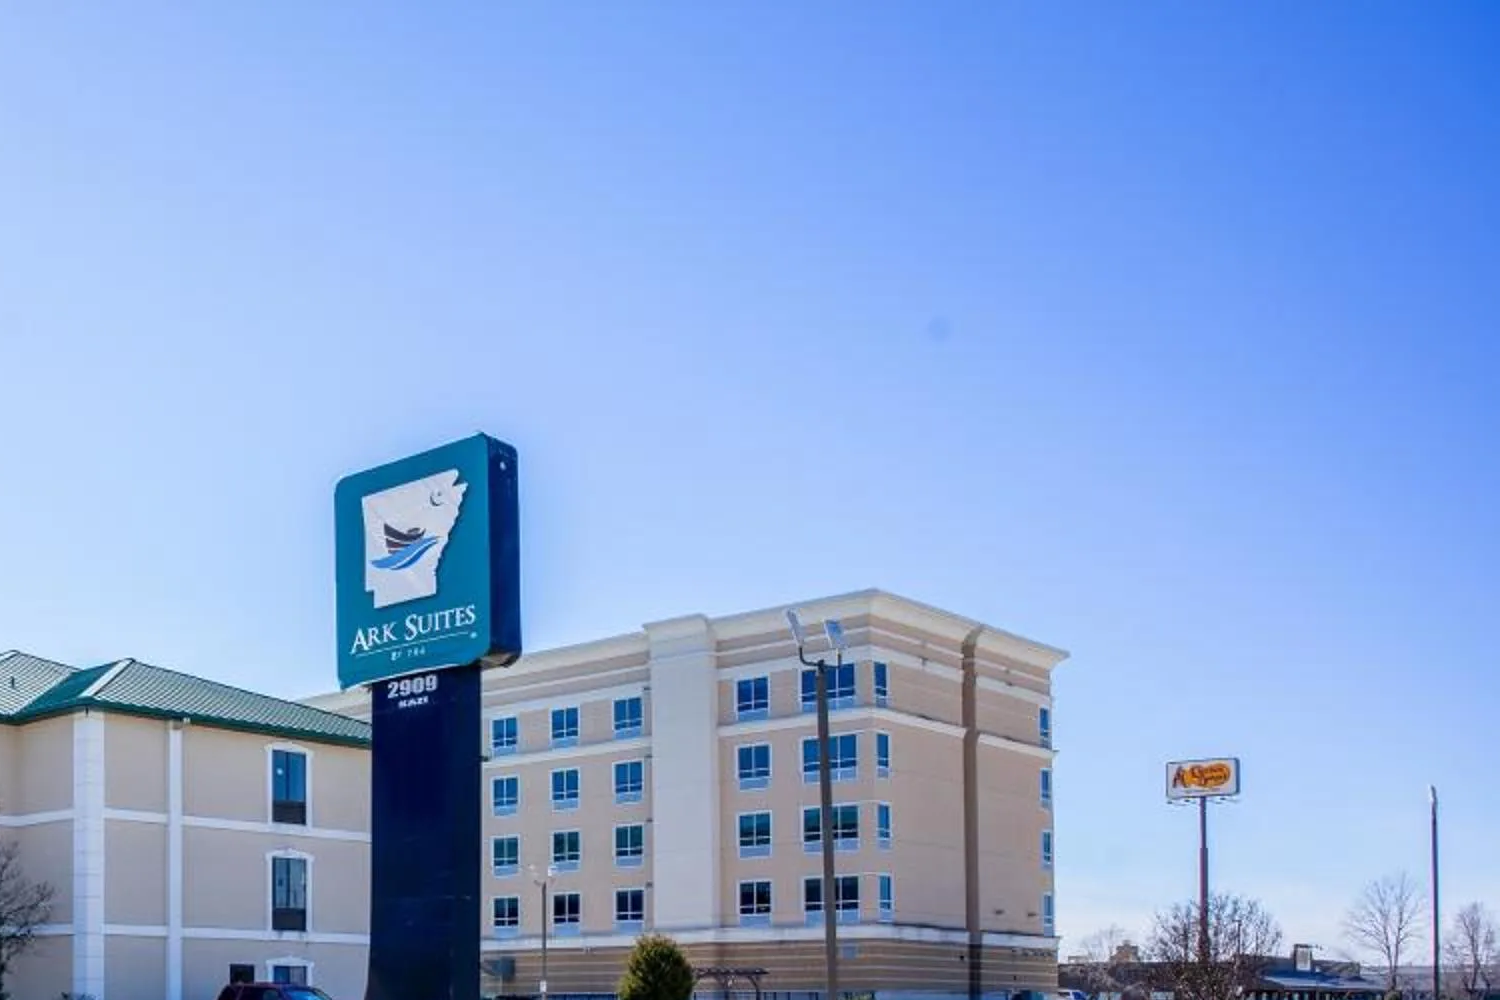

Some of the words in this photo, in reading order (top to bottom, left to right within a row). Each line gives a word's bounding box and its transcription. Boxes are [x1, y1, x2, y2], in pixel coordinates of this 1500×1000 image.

[349, 621, 399, 655] ARK
[403, 604, 477, 641] SUITES
[387, 674, 438, 699] 2909
